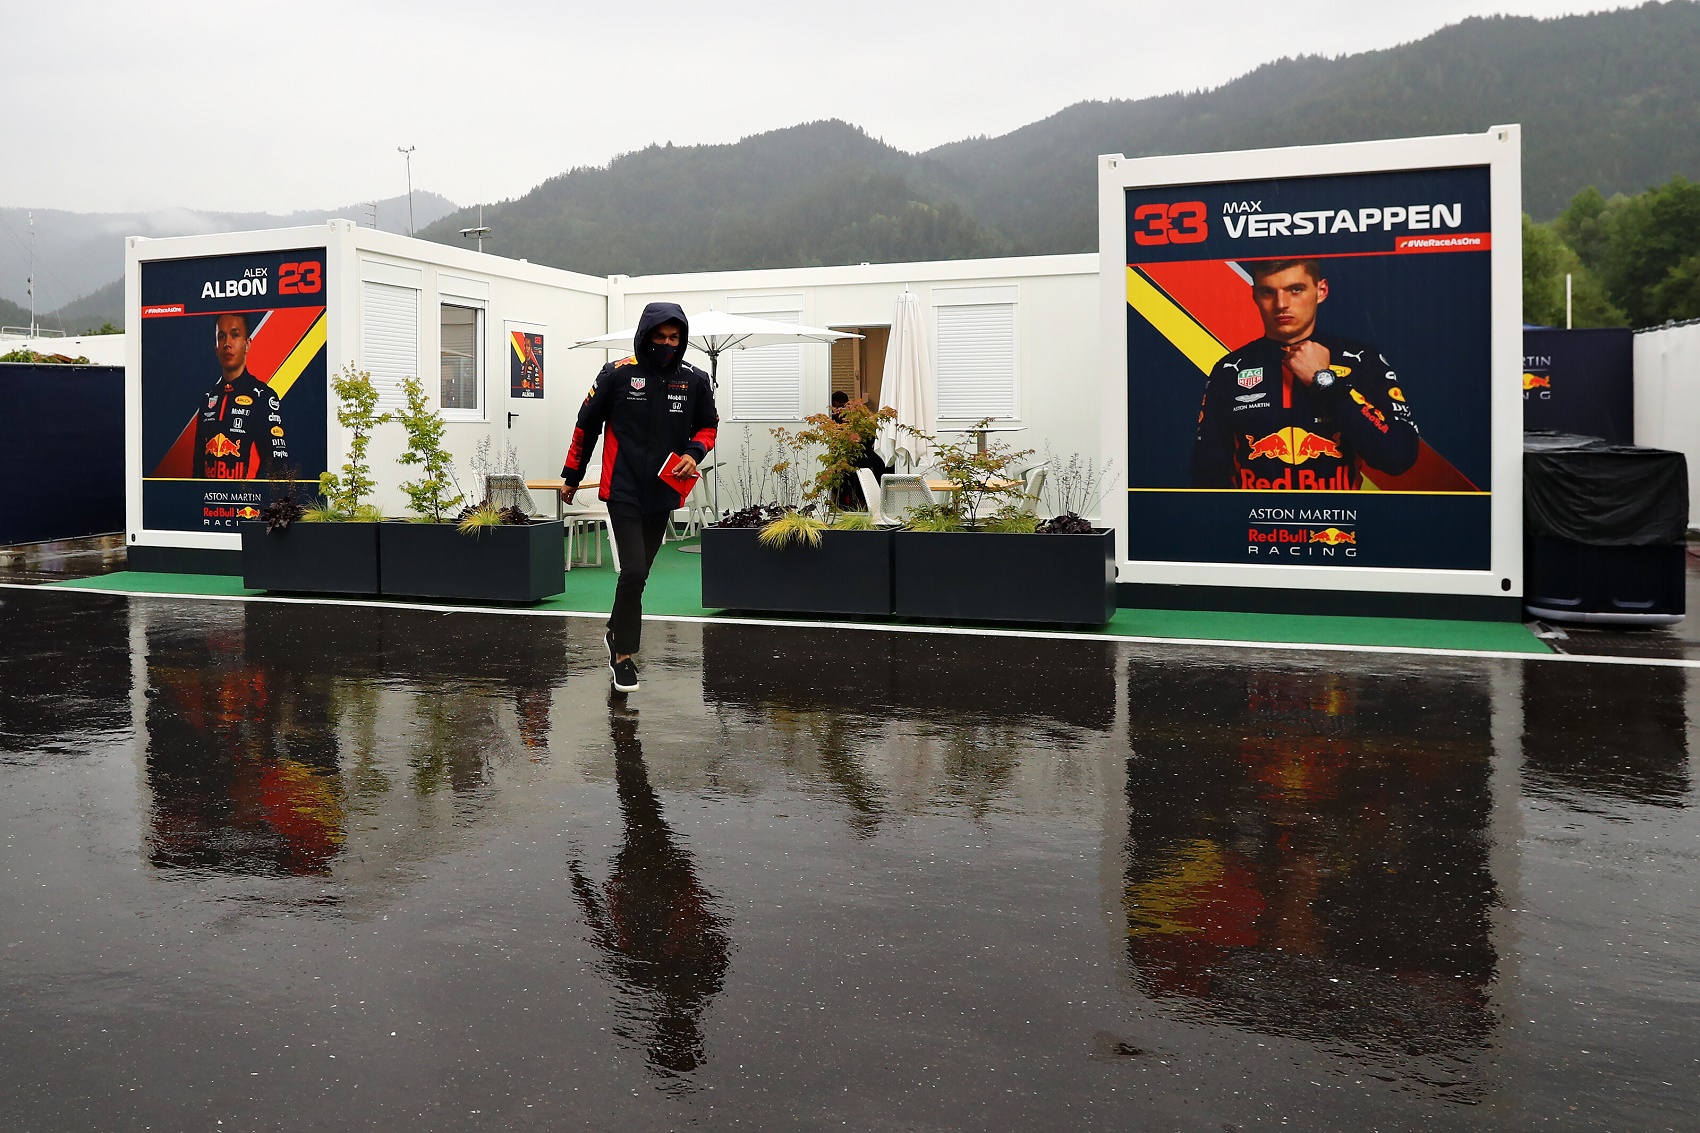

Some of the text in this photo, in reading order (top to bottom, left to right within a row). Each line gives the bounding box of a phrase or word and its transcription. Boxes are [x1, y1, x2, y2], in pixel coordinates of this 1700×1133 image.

[1222, 200, 1262, 214] MAX
[1134, 201, 1208, 246] 33
[1222, 203, 1462, 239] VERSTAPPEN
[1407, 237, 1481, 248] #WeRaceAsOne
[243, 268, 268, 277] ALEX
[278, 261, 322, 295] 23
[201, 278, 268, 299] ALBON
[1523, 356, 1551, 366] TIN
[1241, 369, 1261, 378] TAG
[1239, 375, 1262, 387] HEUER
[217, 461, 244, 480] Bull
[1241, 466, 1350, 490] Red Bull
[203, 492, 262, 502] ASTON MARTIN
[203, 507, 234, 518] Red Bull
[1248, 508, 1357, 521] ASTON MARTIN
[203, 519, 239, 527] RACI
[1248, 528, 1308, 543] Red Bull
[1248, 546, 1357, 557] RACING
